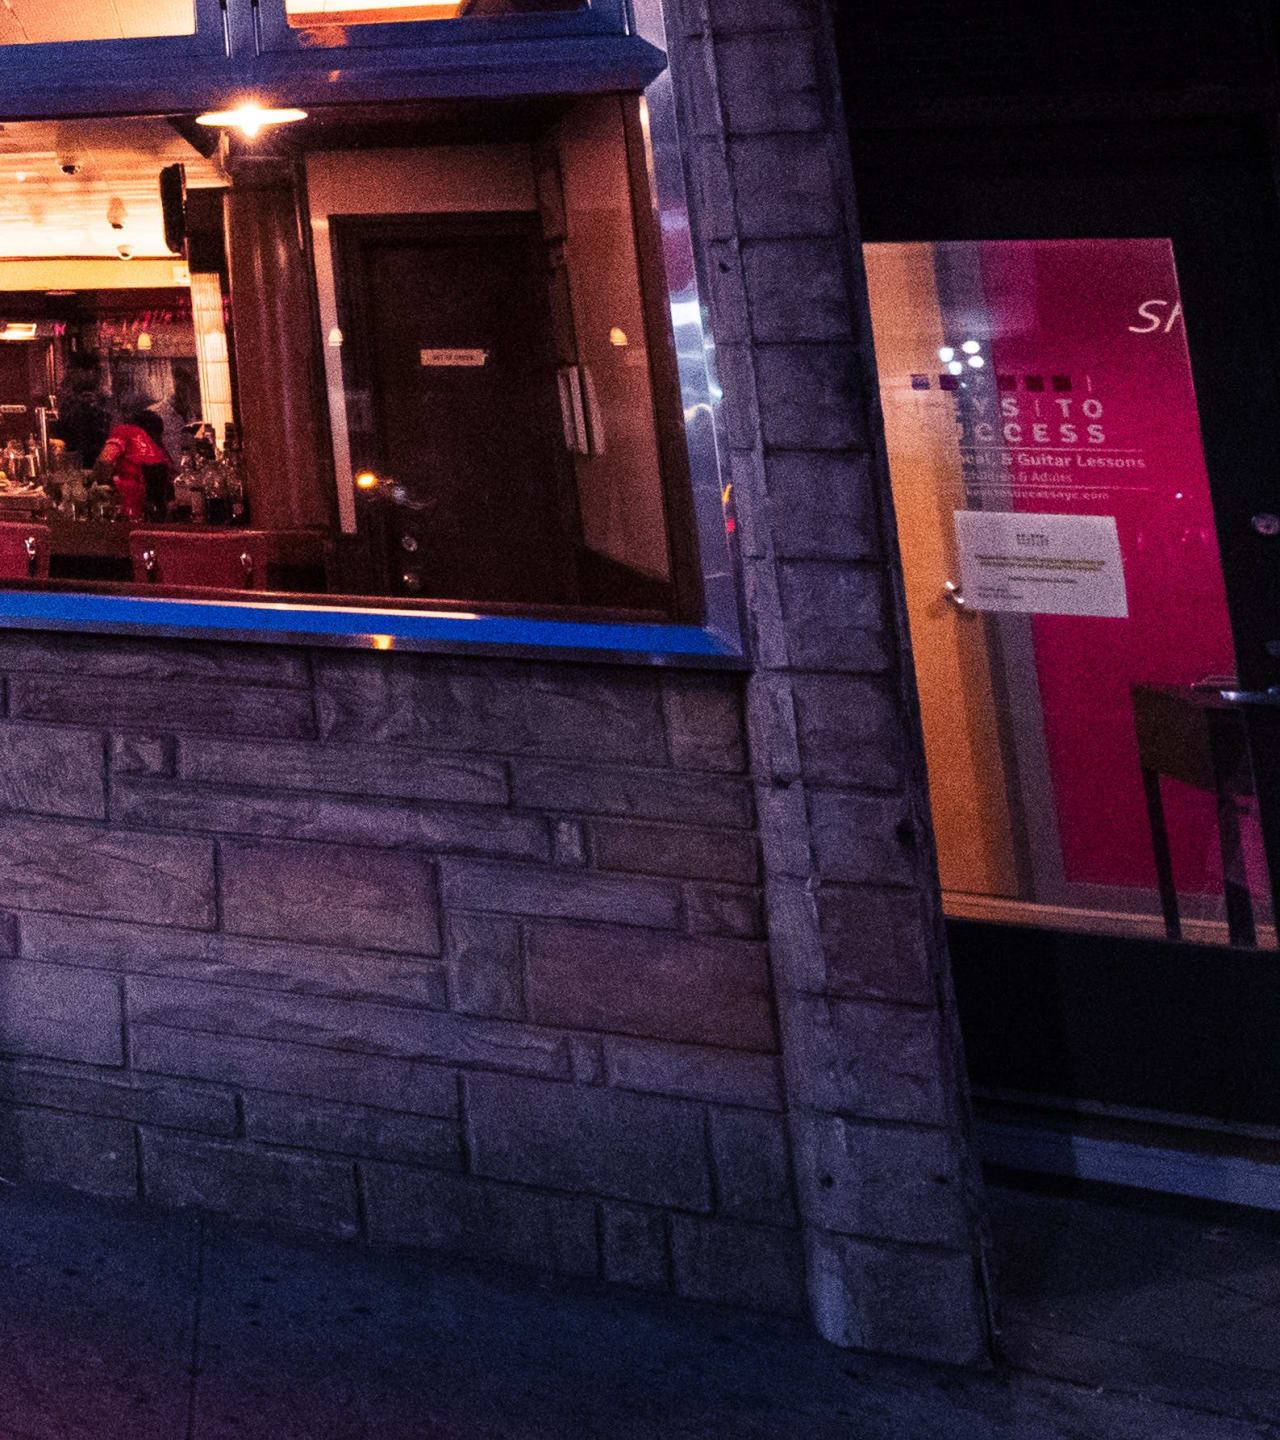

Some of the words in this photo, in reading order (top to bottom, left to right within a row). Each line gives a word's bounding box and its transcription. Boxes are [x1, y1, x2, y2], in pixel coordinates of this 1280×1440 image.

[1054, 398, 1104, 419] TO
[1016, 452, 1072, 468] Guitar
[1076, 453, 1147, 469] Lessons
